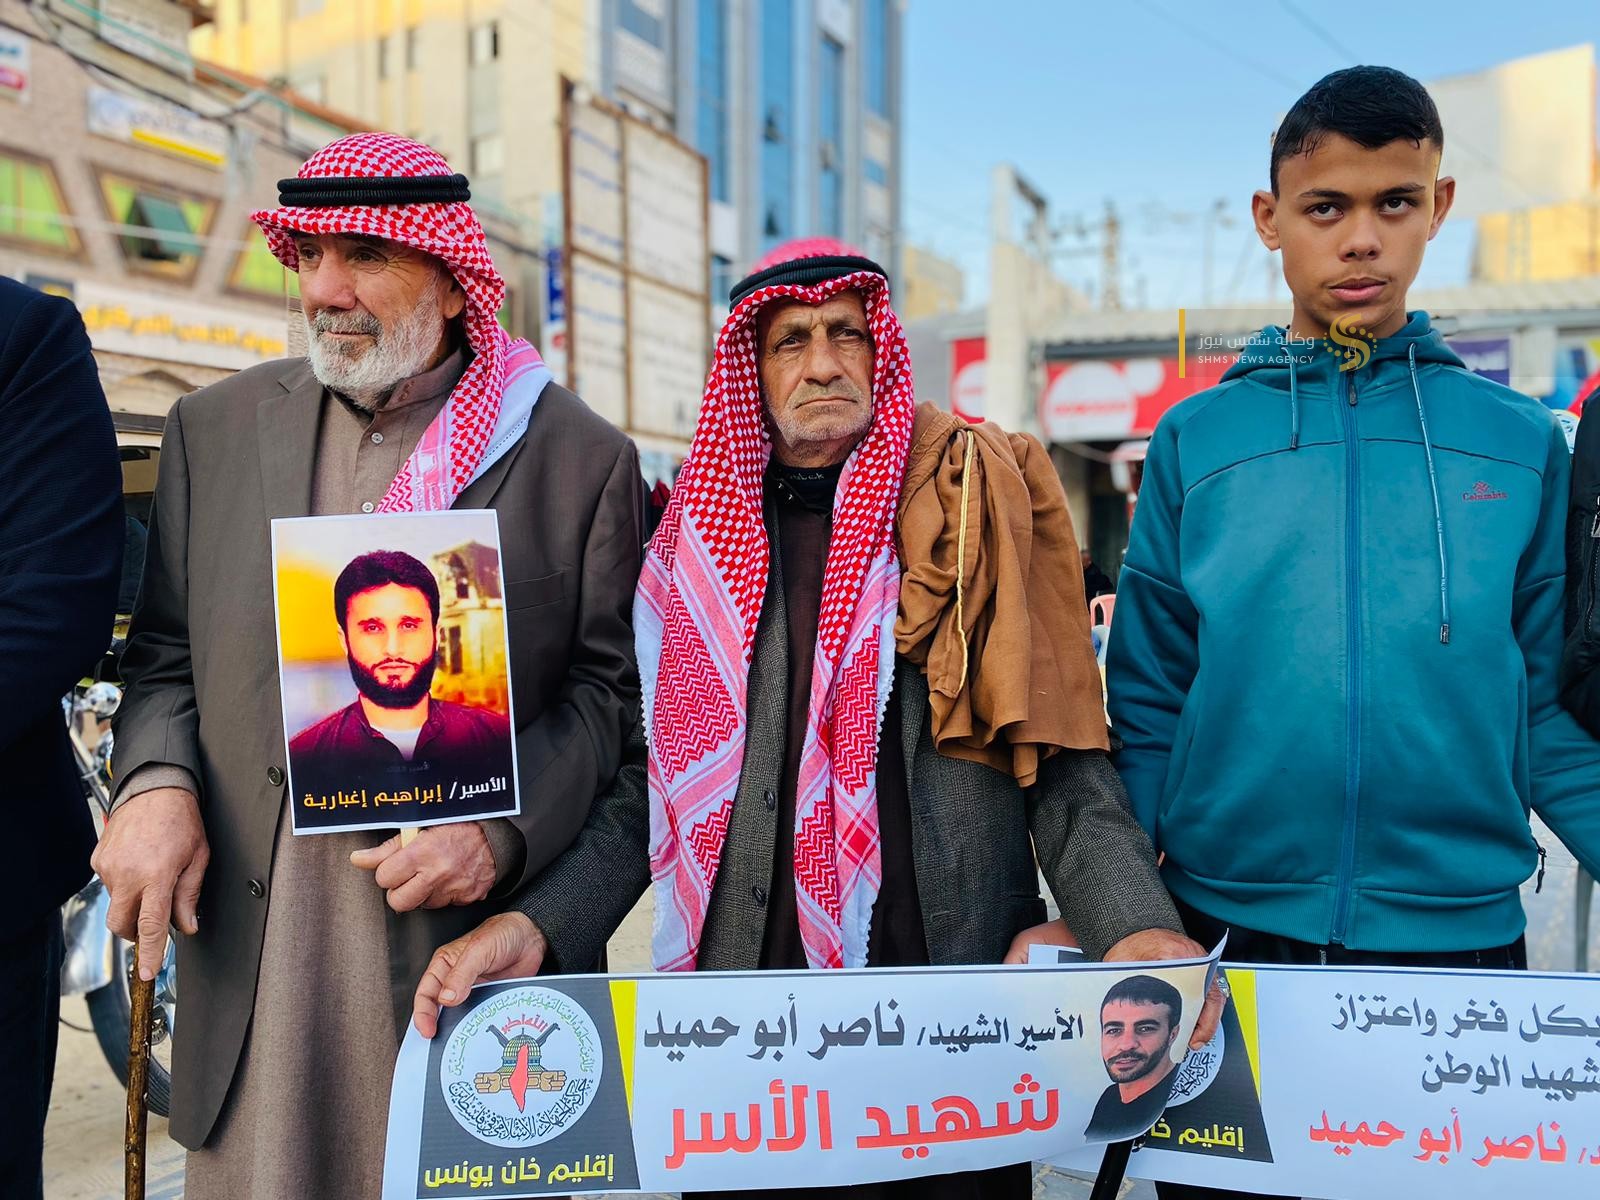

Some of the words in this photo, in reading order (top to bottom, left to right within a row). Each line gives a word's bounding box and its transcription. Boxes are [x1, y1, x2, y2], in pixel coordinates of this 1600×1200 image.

[303, 789, 367, 810] إغبارية
[373, 784, 443, 808] إبراهيم
[644, 1010, 740, 1062] حميد
[747, 993, 799, 1062] أبو
[807, 998, 906, 1061] ناصر
[1014, 1008, 1084, 1050] الأسير
[1331, 992, 1438, 1037] واعتزاز
[1445, 998, 1509, 1039] فخر
[1421, 1050, 1511, 1095] الوطن
[664, 1078, 834, 1170] الأسر
[856, 1073, 1061, 1161] شهيد
[1150, 1117, 1172, 1139] خا
[1178, 1124, 1245, 1152] إقليم
[1309, 1109, 1405, 1156] حميد
[1413, 1106, 1463, 1165] أبو
[1471, 1120, 1568, 1168] ناصر
[424, 1160, 494, 1188] يونس
[501, 1157, 541, 1184] خان
[547, 1153, 615, 1182] إقليم
